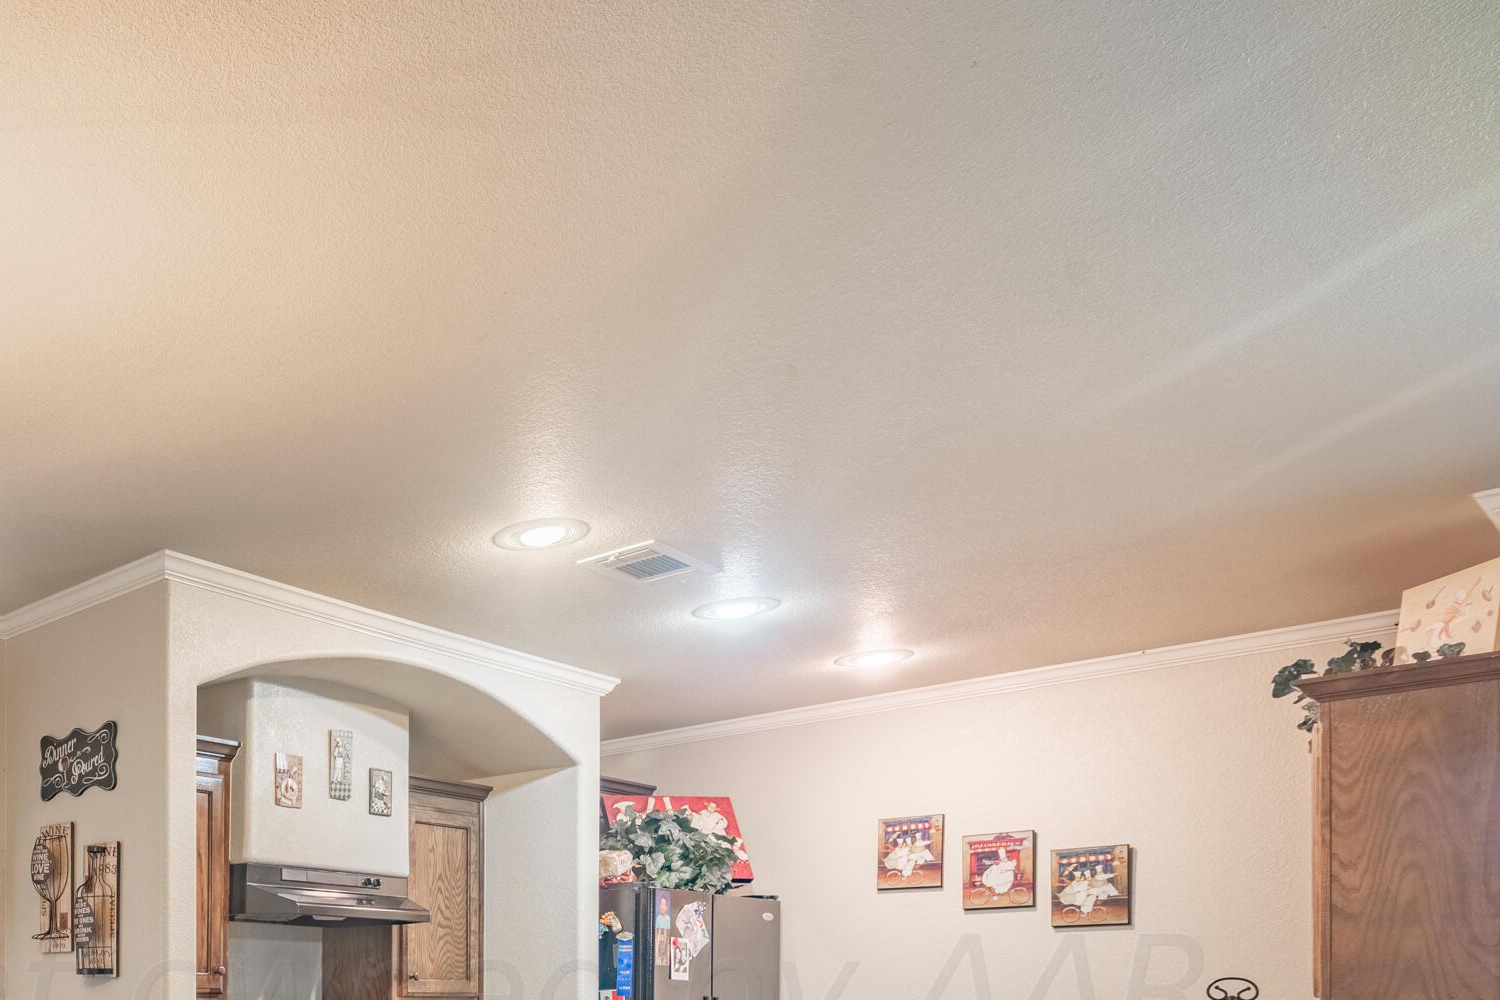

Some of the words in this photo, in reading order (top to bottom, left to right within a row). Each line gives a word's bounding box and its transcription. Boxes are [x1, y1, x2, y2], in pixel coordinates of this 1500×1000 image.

[42, 738, 77, 768] Dinner
[71, 745, 105, 785] Poured
[32, 863, 50, 874] LOVE
